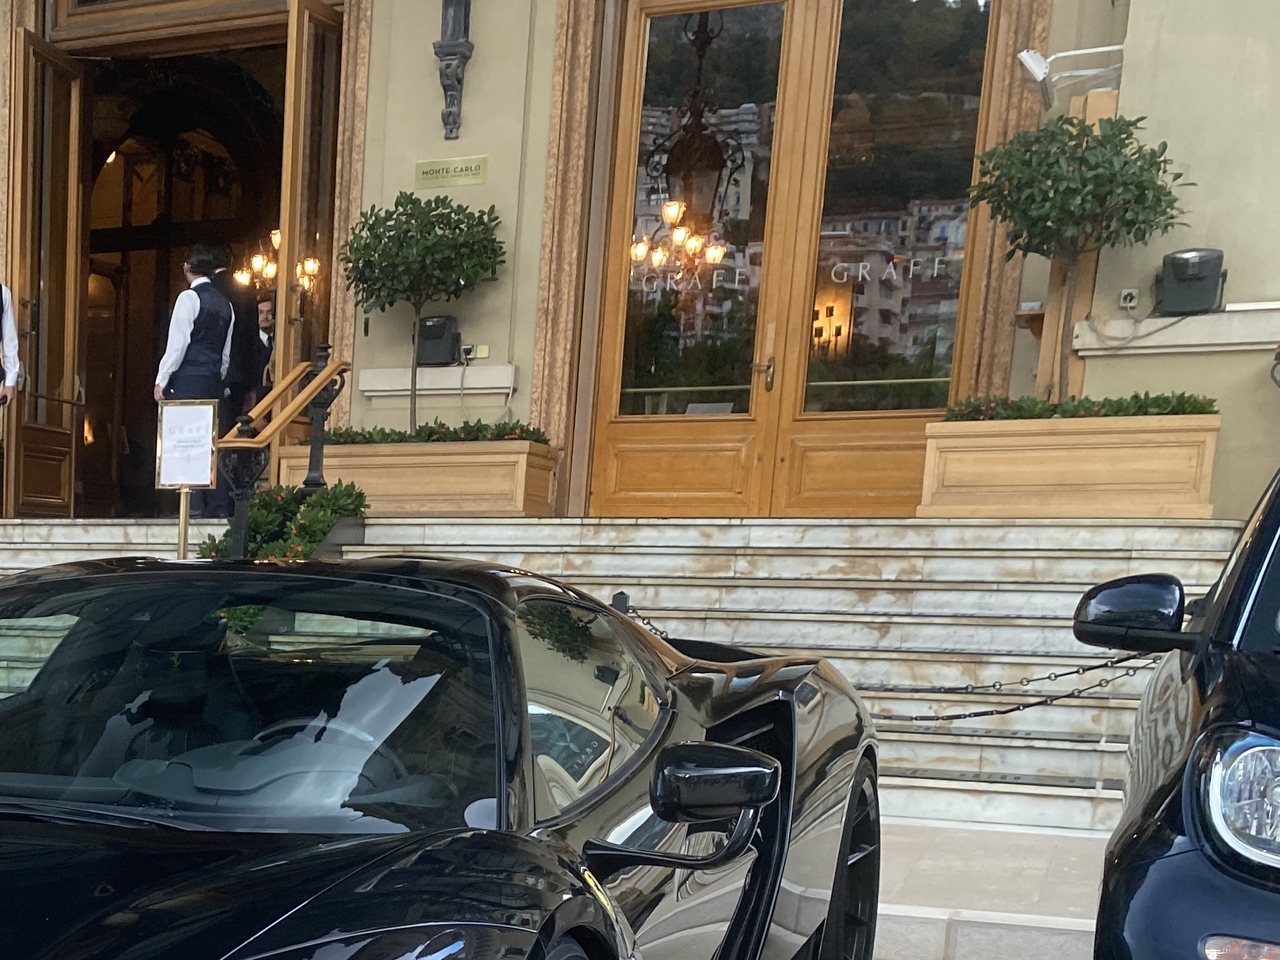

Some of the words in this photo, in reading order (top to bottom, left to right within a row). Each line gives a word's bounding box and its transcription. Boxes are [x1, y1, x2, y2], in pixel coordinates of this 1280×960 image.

[422, 165, 481, 176] MONTE-CARLO
[642, 268, 747, 292] GRAFF
[831, 257, 946, 283] GRAFF
